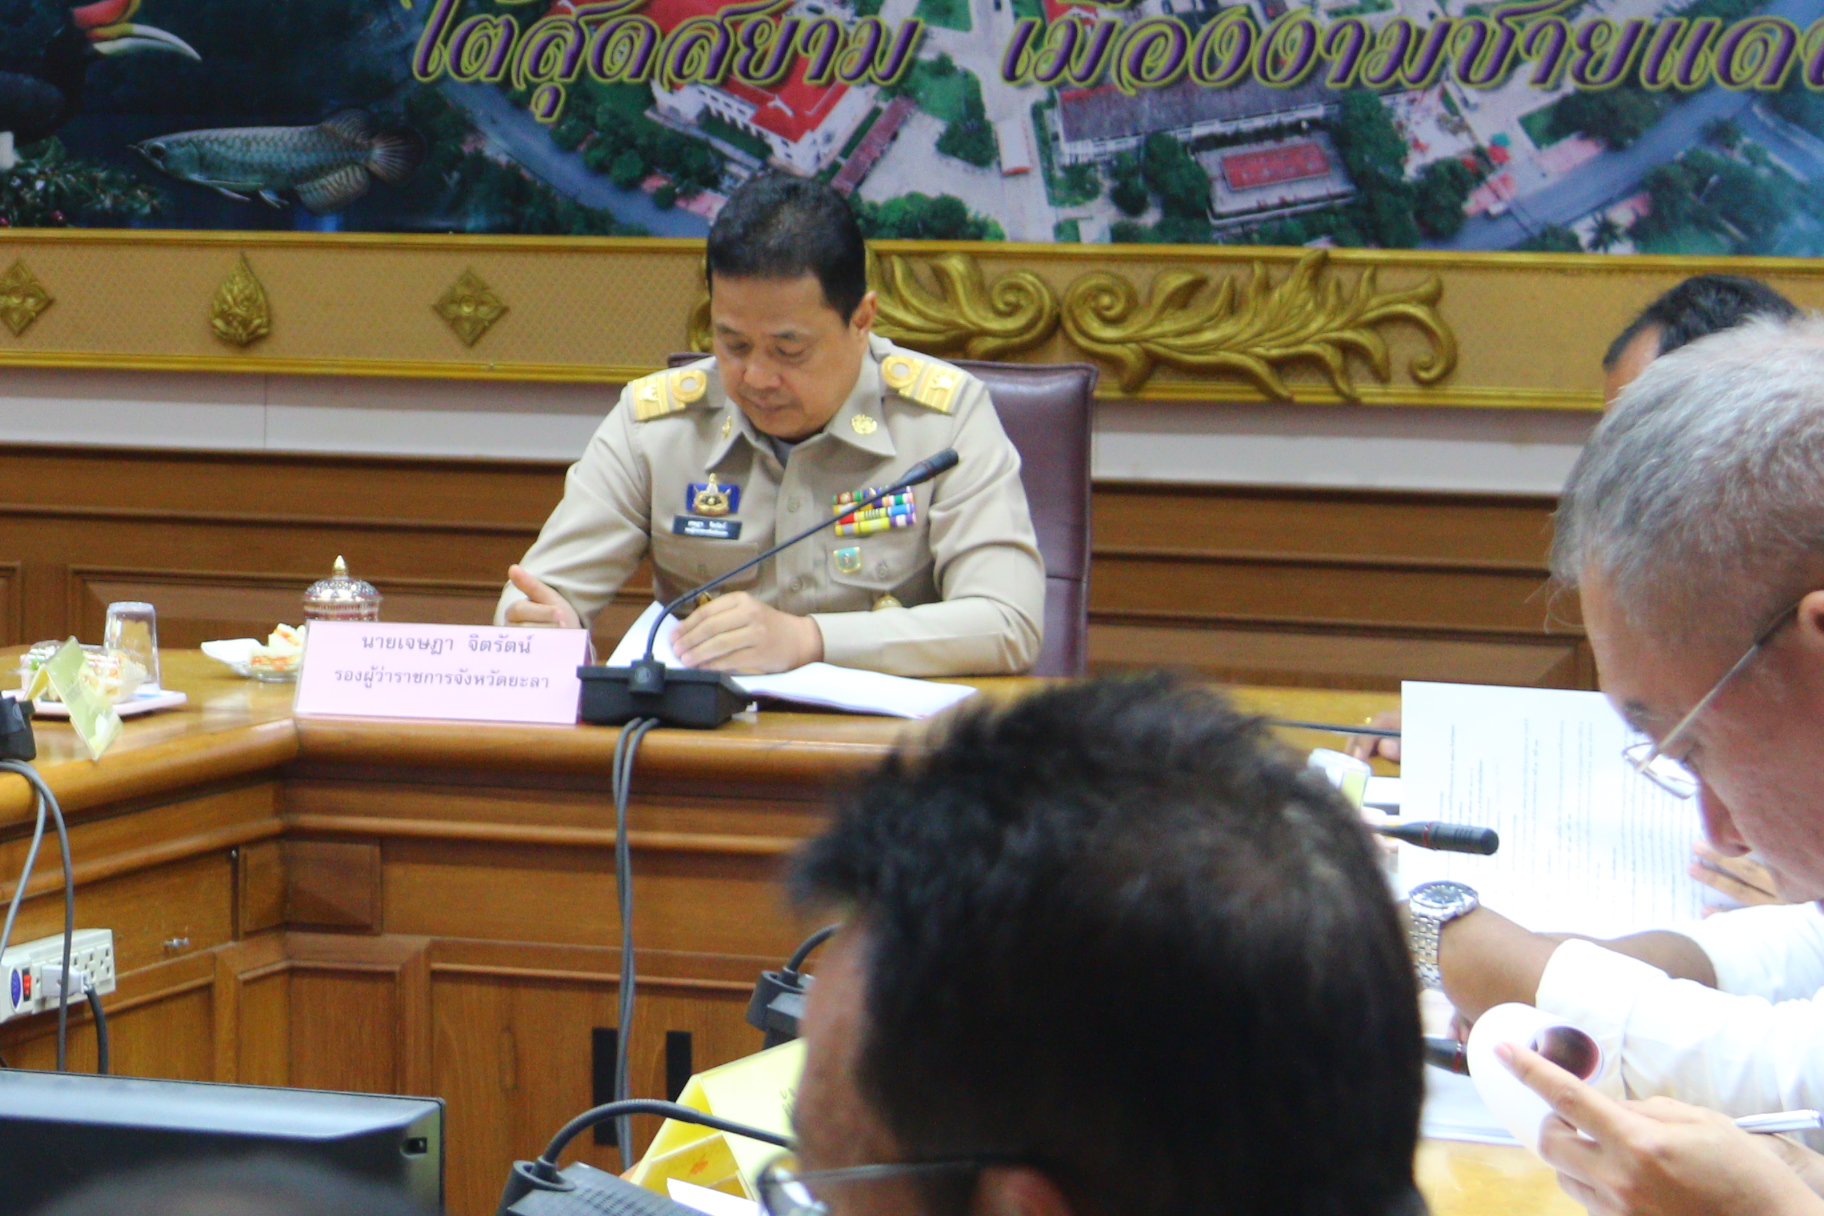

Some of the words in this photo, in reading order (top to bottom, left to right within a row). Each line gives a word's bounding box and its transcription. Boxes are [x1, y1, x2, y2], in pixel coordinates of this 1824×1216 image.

[335, 666, 549, 689] รองผู้ว่าราชการจังหวัดยะลา
